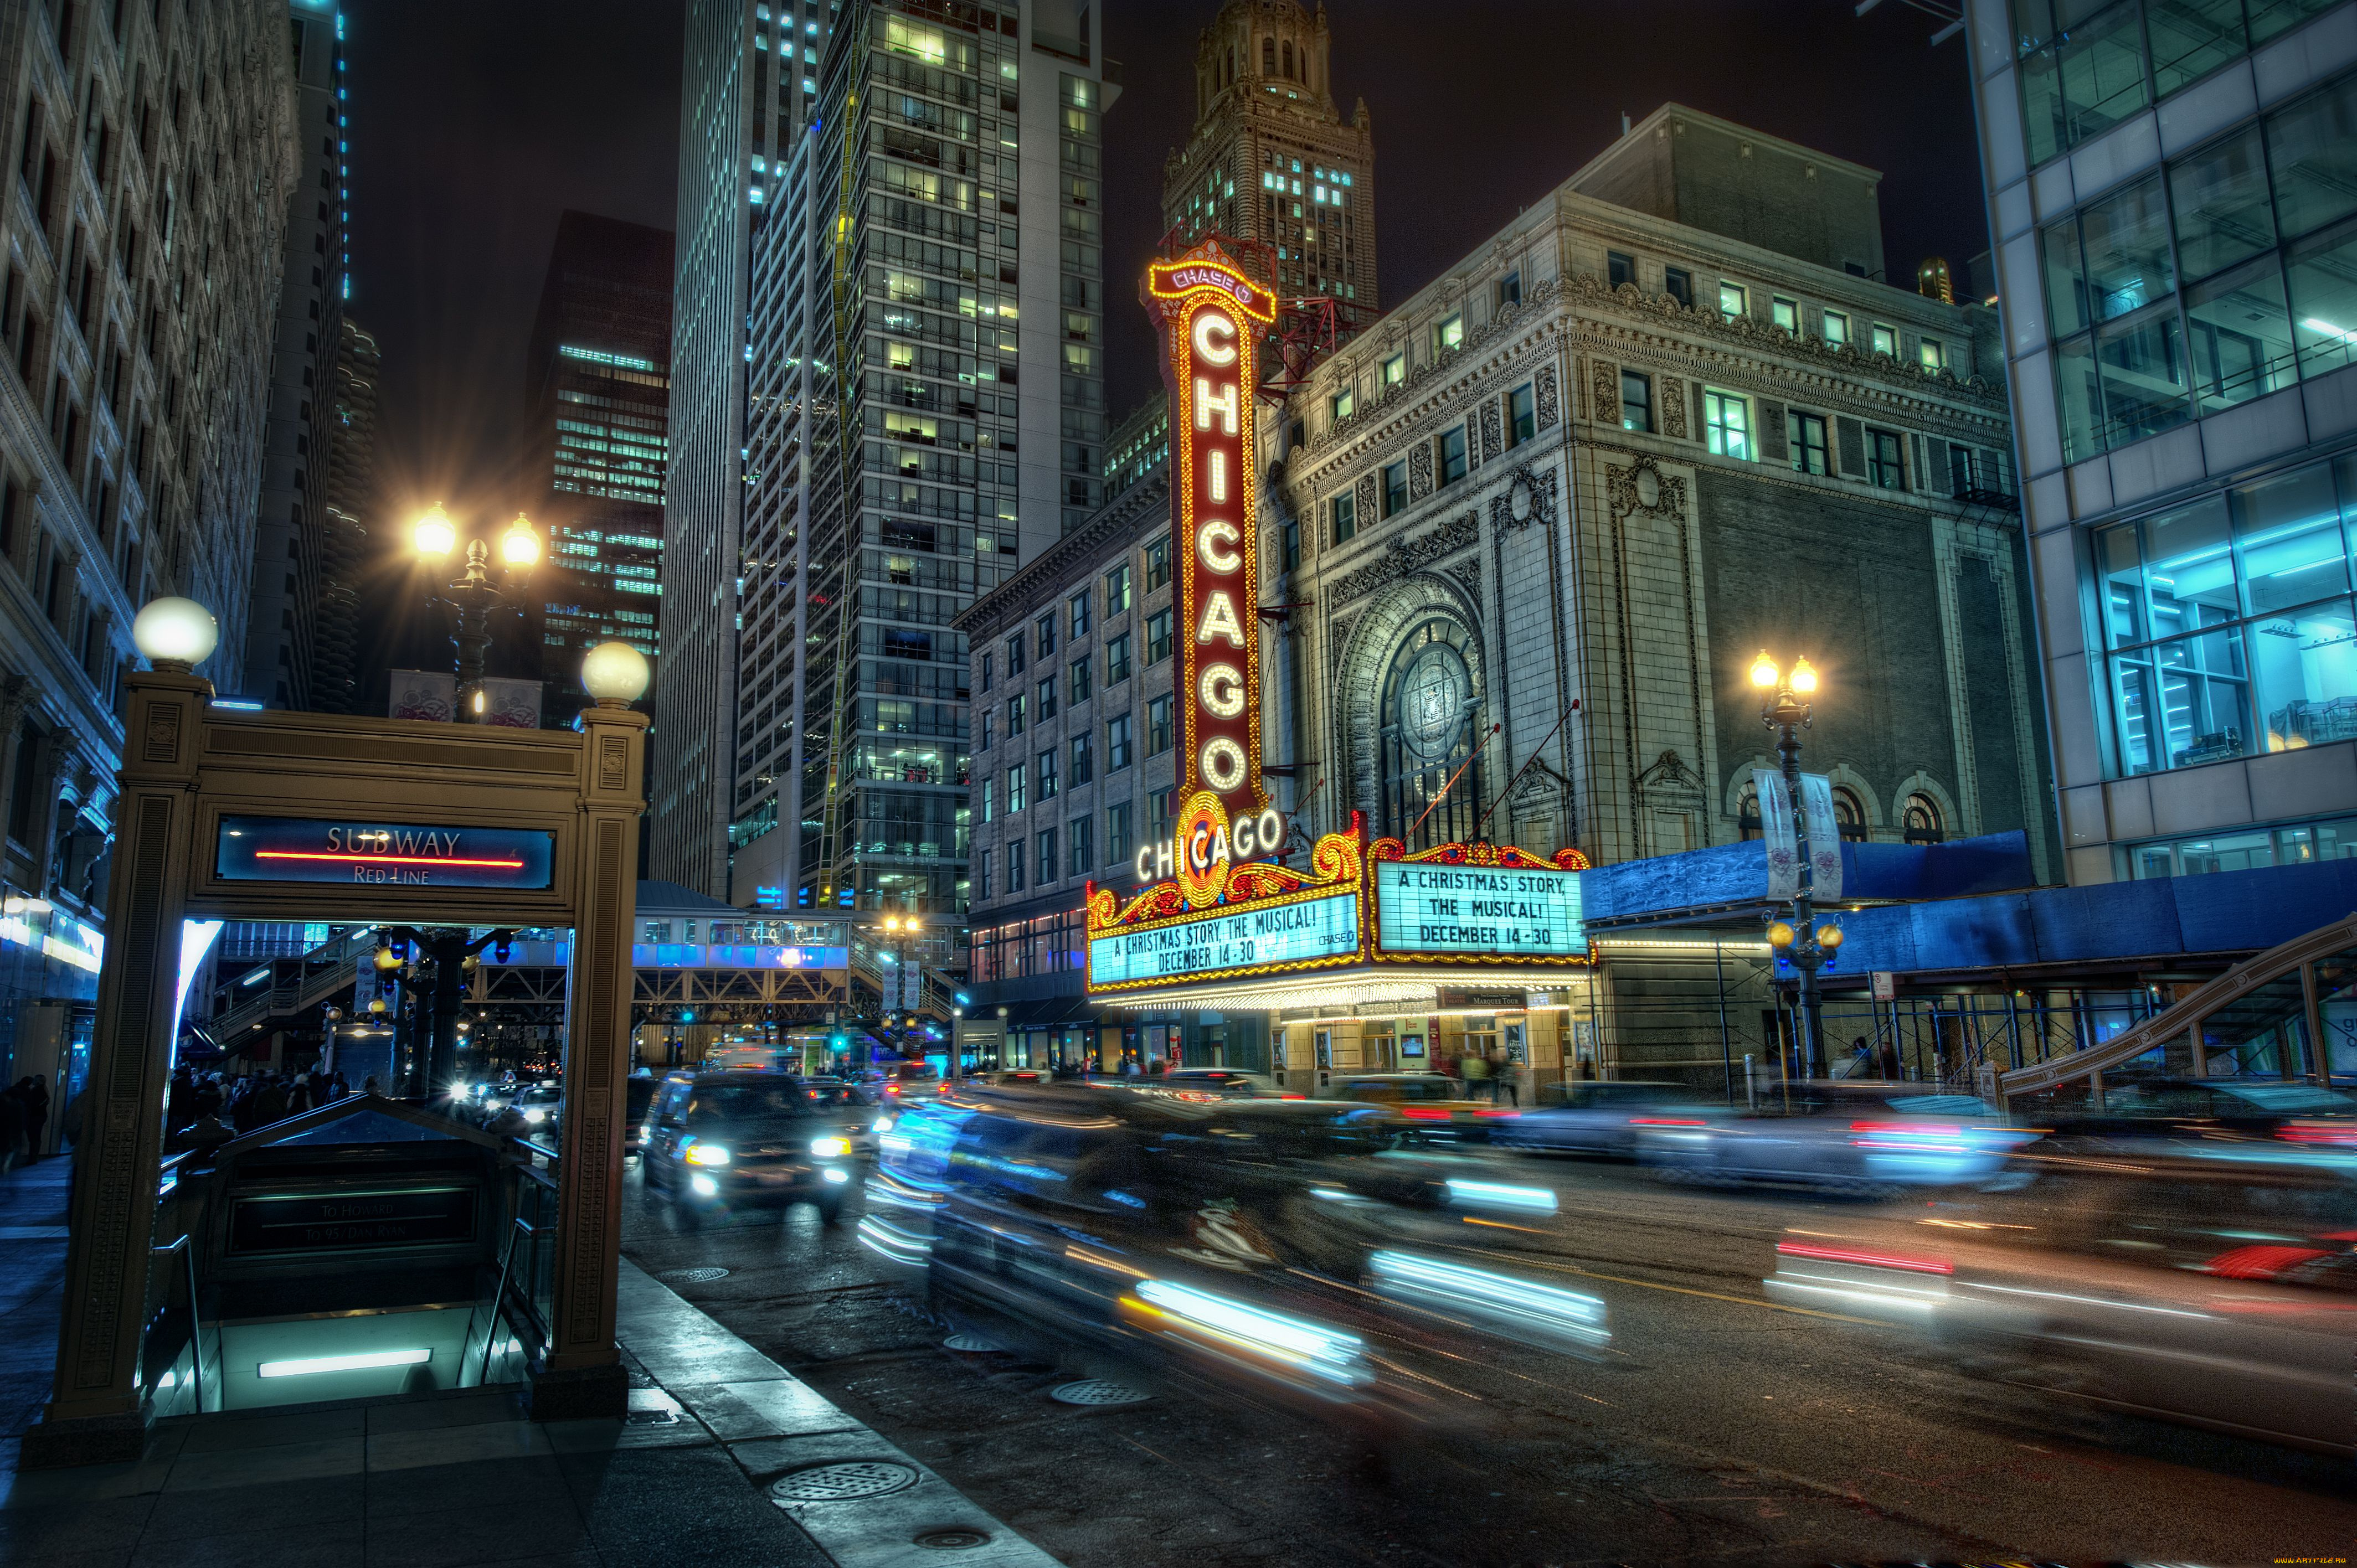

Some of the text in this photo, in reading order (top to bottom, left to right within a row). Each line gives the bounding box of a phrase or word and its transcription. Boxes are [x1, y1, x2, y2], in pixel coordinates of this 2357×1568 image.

[1173, 268, 1236, 292] CHASE
[1193, 313, 1248, 793] CHICAGO
[326, 827, 461, 857] SUBWAY
[1137, 808, 1280, 882] CHICAGO
[1398, 870, 1566, 896] A CHRISTMAS STORY,
[1428, 898, 1543, 919] THE MUSICAL!
[1114, 904, 1316, 957] A CHRISTMAS STORY, THE MUSICAL!
[1318, 933, 1346, 946] CHASE
[1419, 925, 1498, 944] DECEMBER
[1159, 950, 1212, 973] DECEMBER
